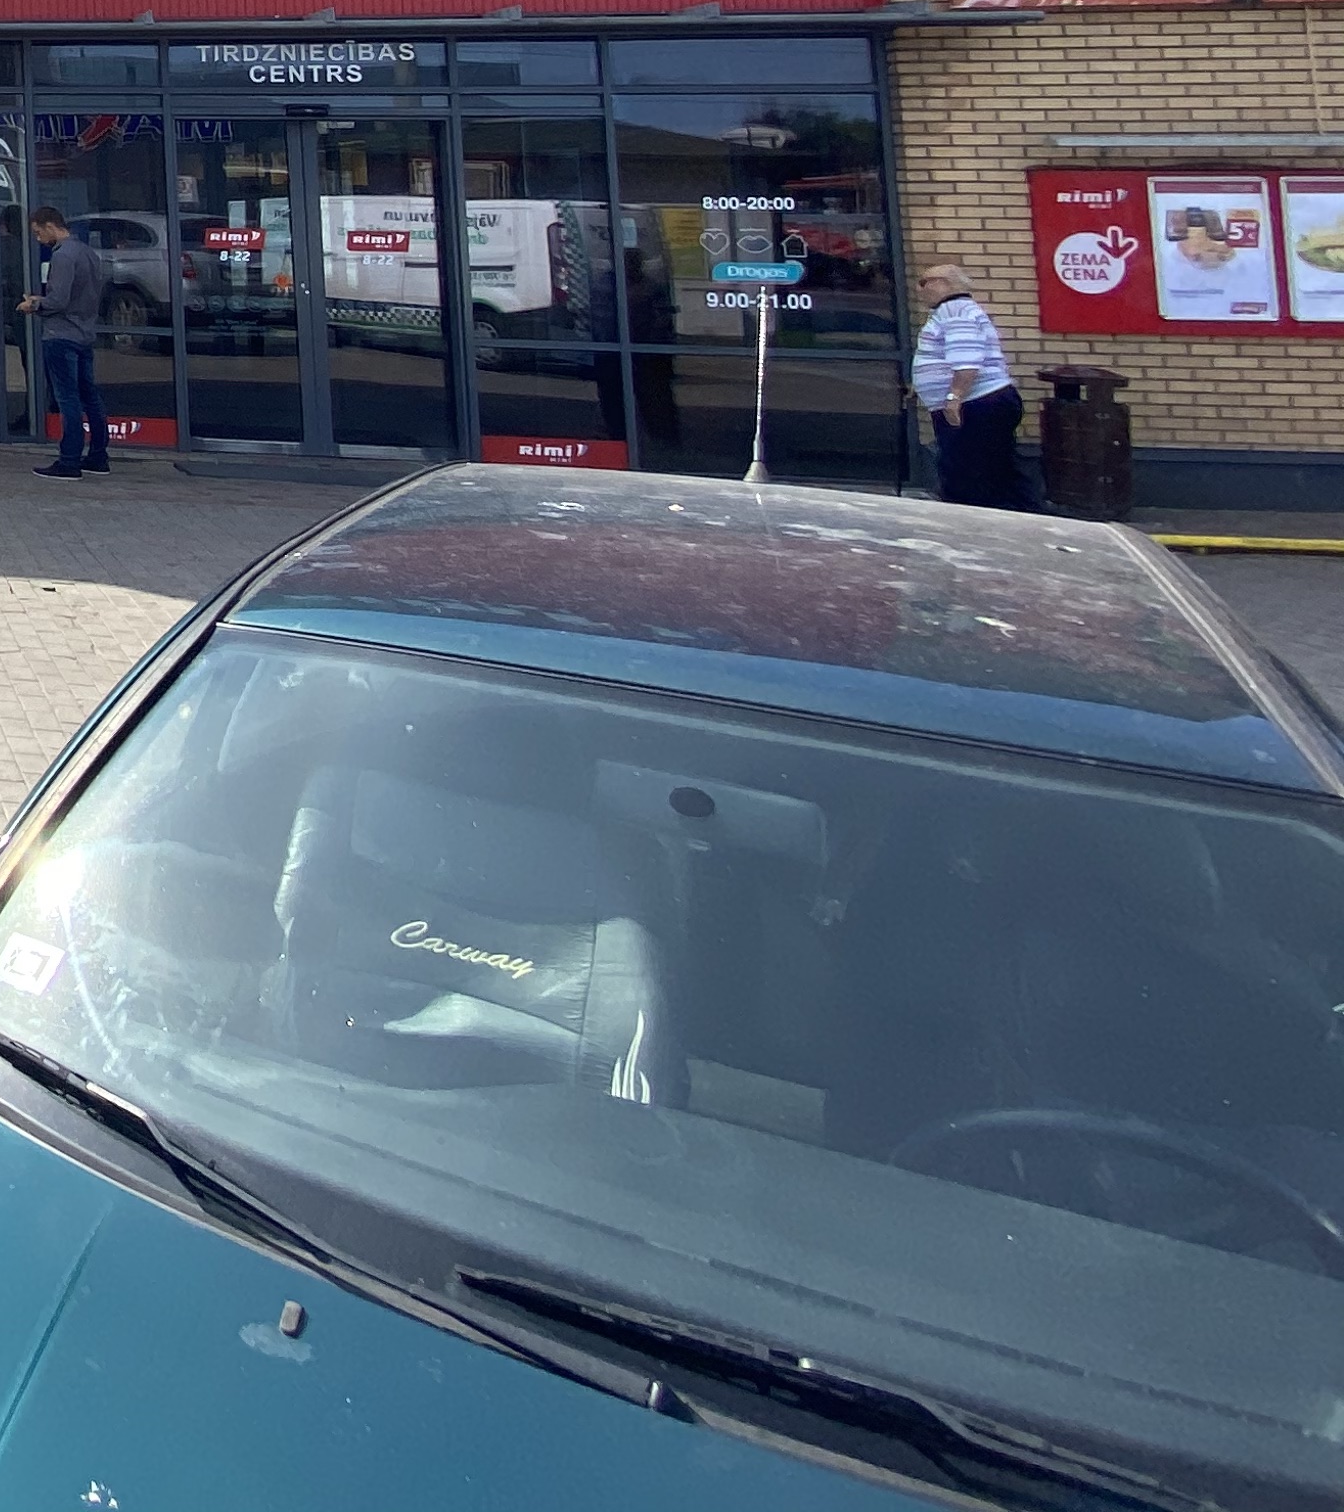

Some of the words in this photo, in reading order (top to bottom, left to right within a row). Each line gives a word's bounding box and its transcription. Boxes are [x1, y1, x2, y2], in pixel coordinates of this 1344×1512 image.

[195, 40, 416, 63] TIRDZNIECĪBAS
[248, 64, 363, 84] CENTRS
[702, 196, 796, 210] 8:00-20:00
[219, 250, 251, 262] 8-22
[362, 254, 395, 266] 8-22
[1060, 253, 1111, 266] ZEMA
[726, 265, 789, 279] Drogas
[1061, 268, 1109, 281] CENA
[518, 443, 573, 457] Rimi
[390, 920, 535, 980] Carway
